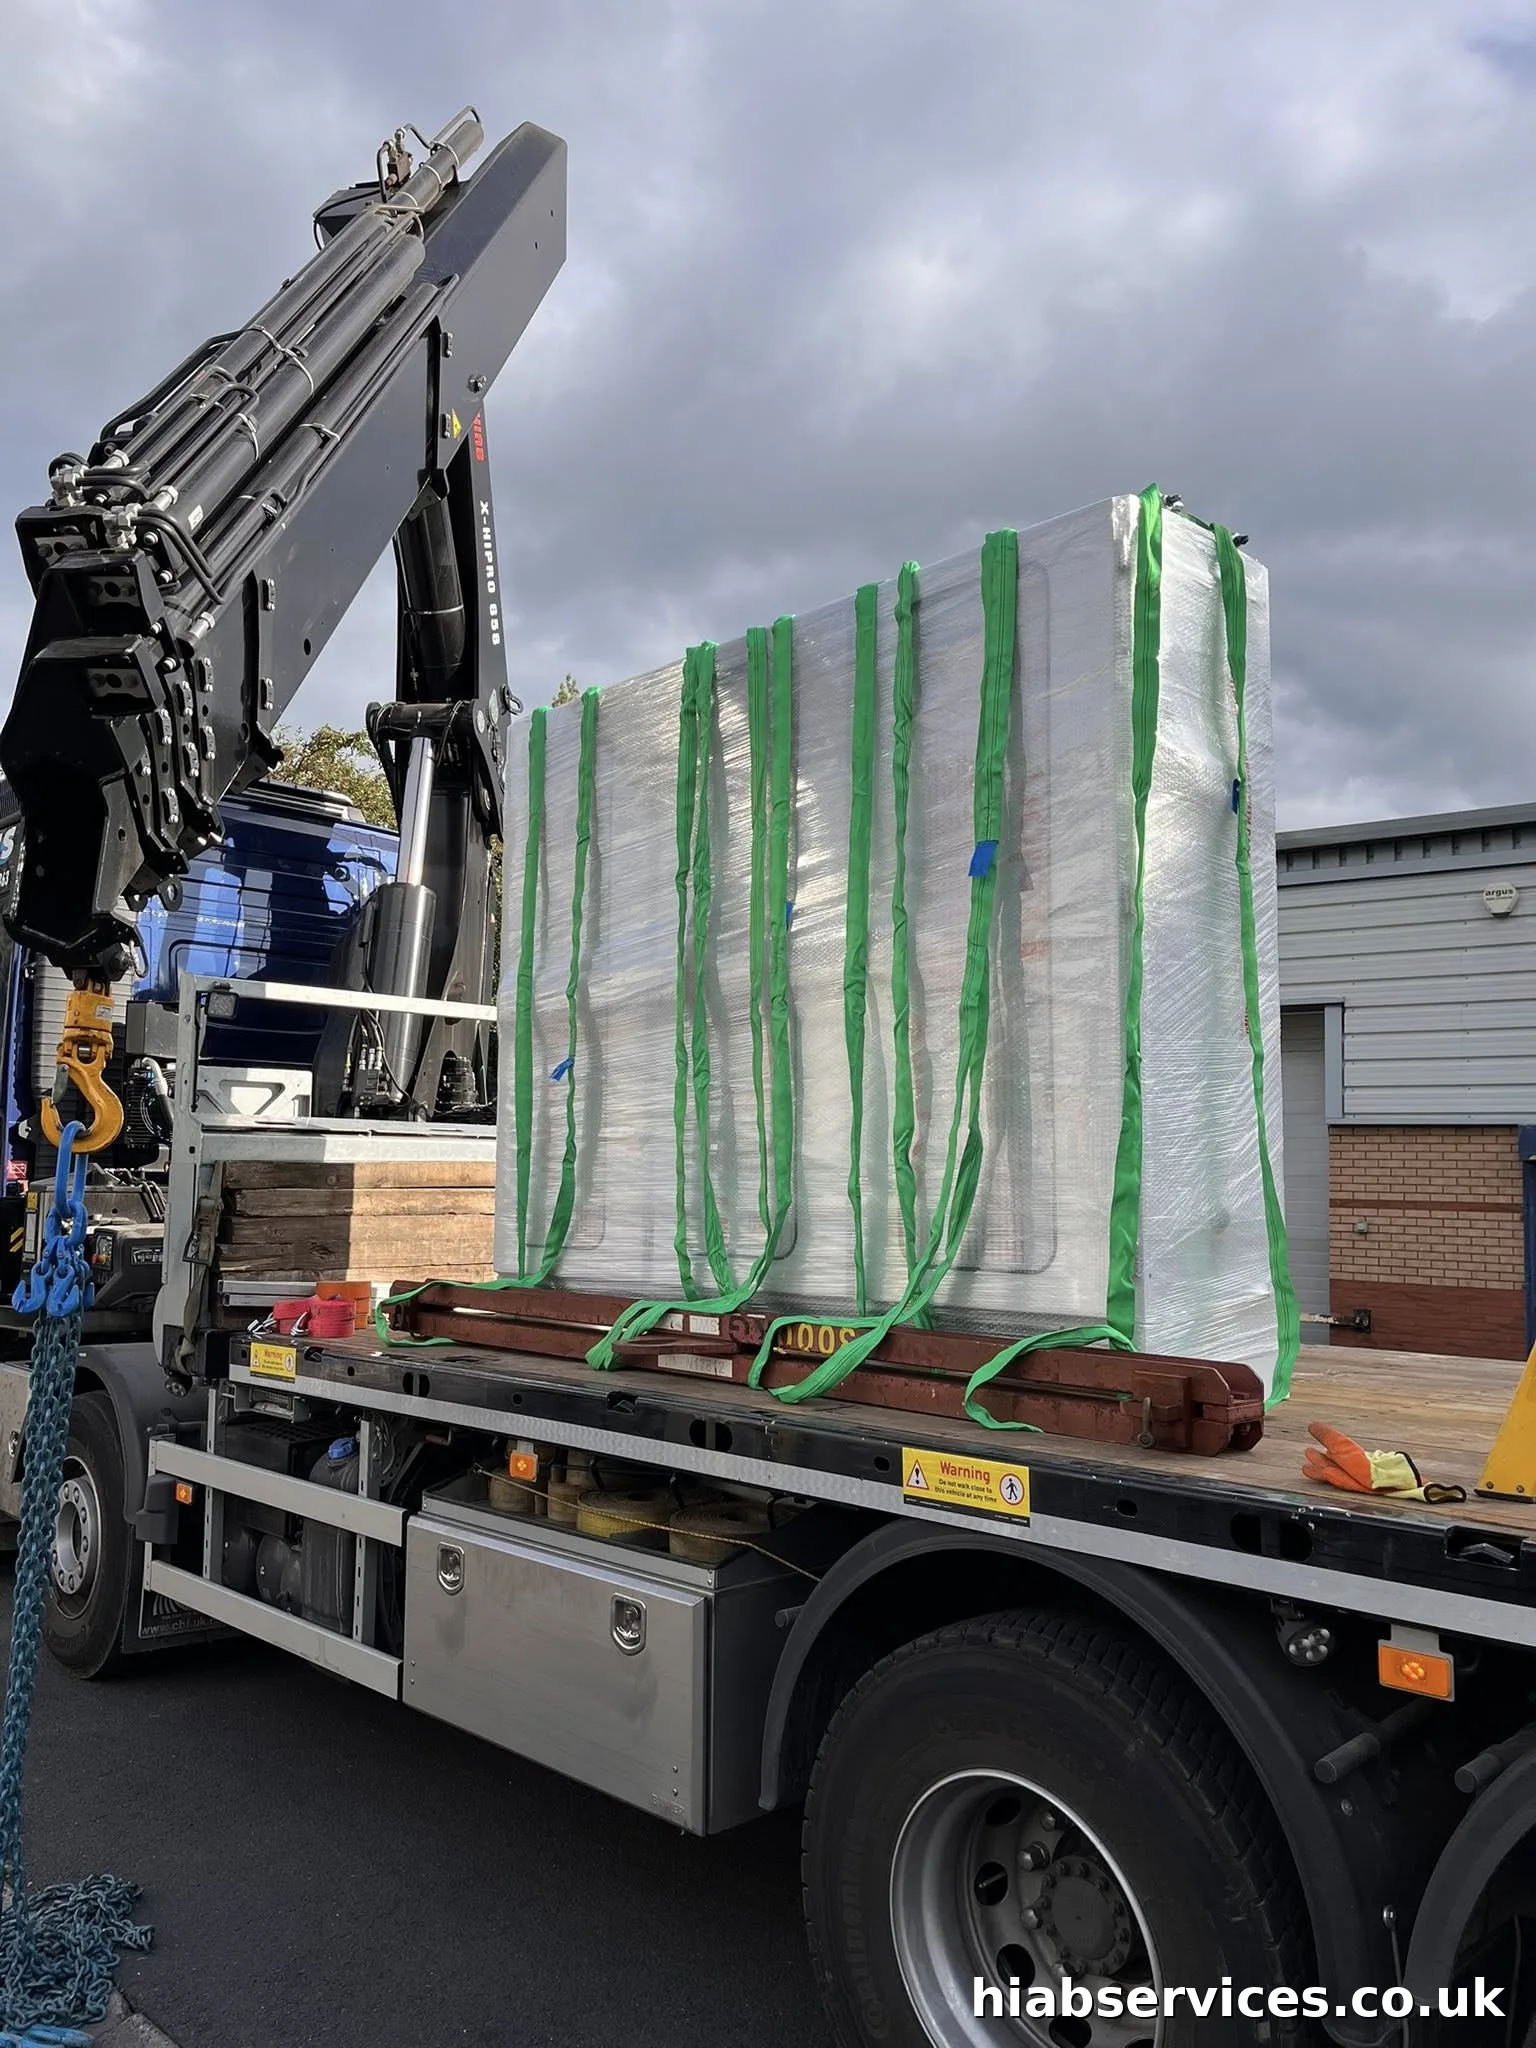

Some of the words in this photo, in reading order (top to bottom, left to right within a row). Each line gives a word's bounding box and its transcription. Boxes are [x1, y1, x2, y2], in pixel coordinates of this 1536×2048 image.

[480, 500, 496, 593] X-HIPRO
[489, 603, 500, 646] 658
[1485, 889, 1514, 897] argus
[940, 1460, 991, 1485] Warning
[939, 1478, 947, 1486] Do
[957, 1482, 970, 1490] walk
[970, 1484, 985, 1493] close
[935, 1486, 946, 1494] this
[946, 1488, 965, 1498] vehicle
[966, 1491, 973, 1499] at
[973, 1493, 984, 1502] any
[984, 1495, 997, 1504] time
